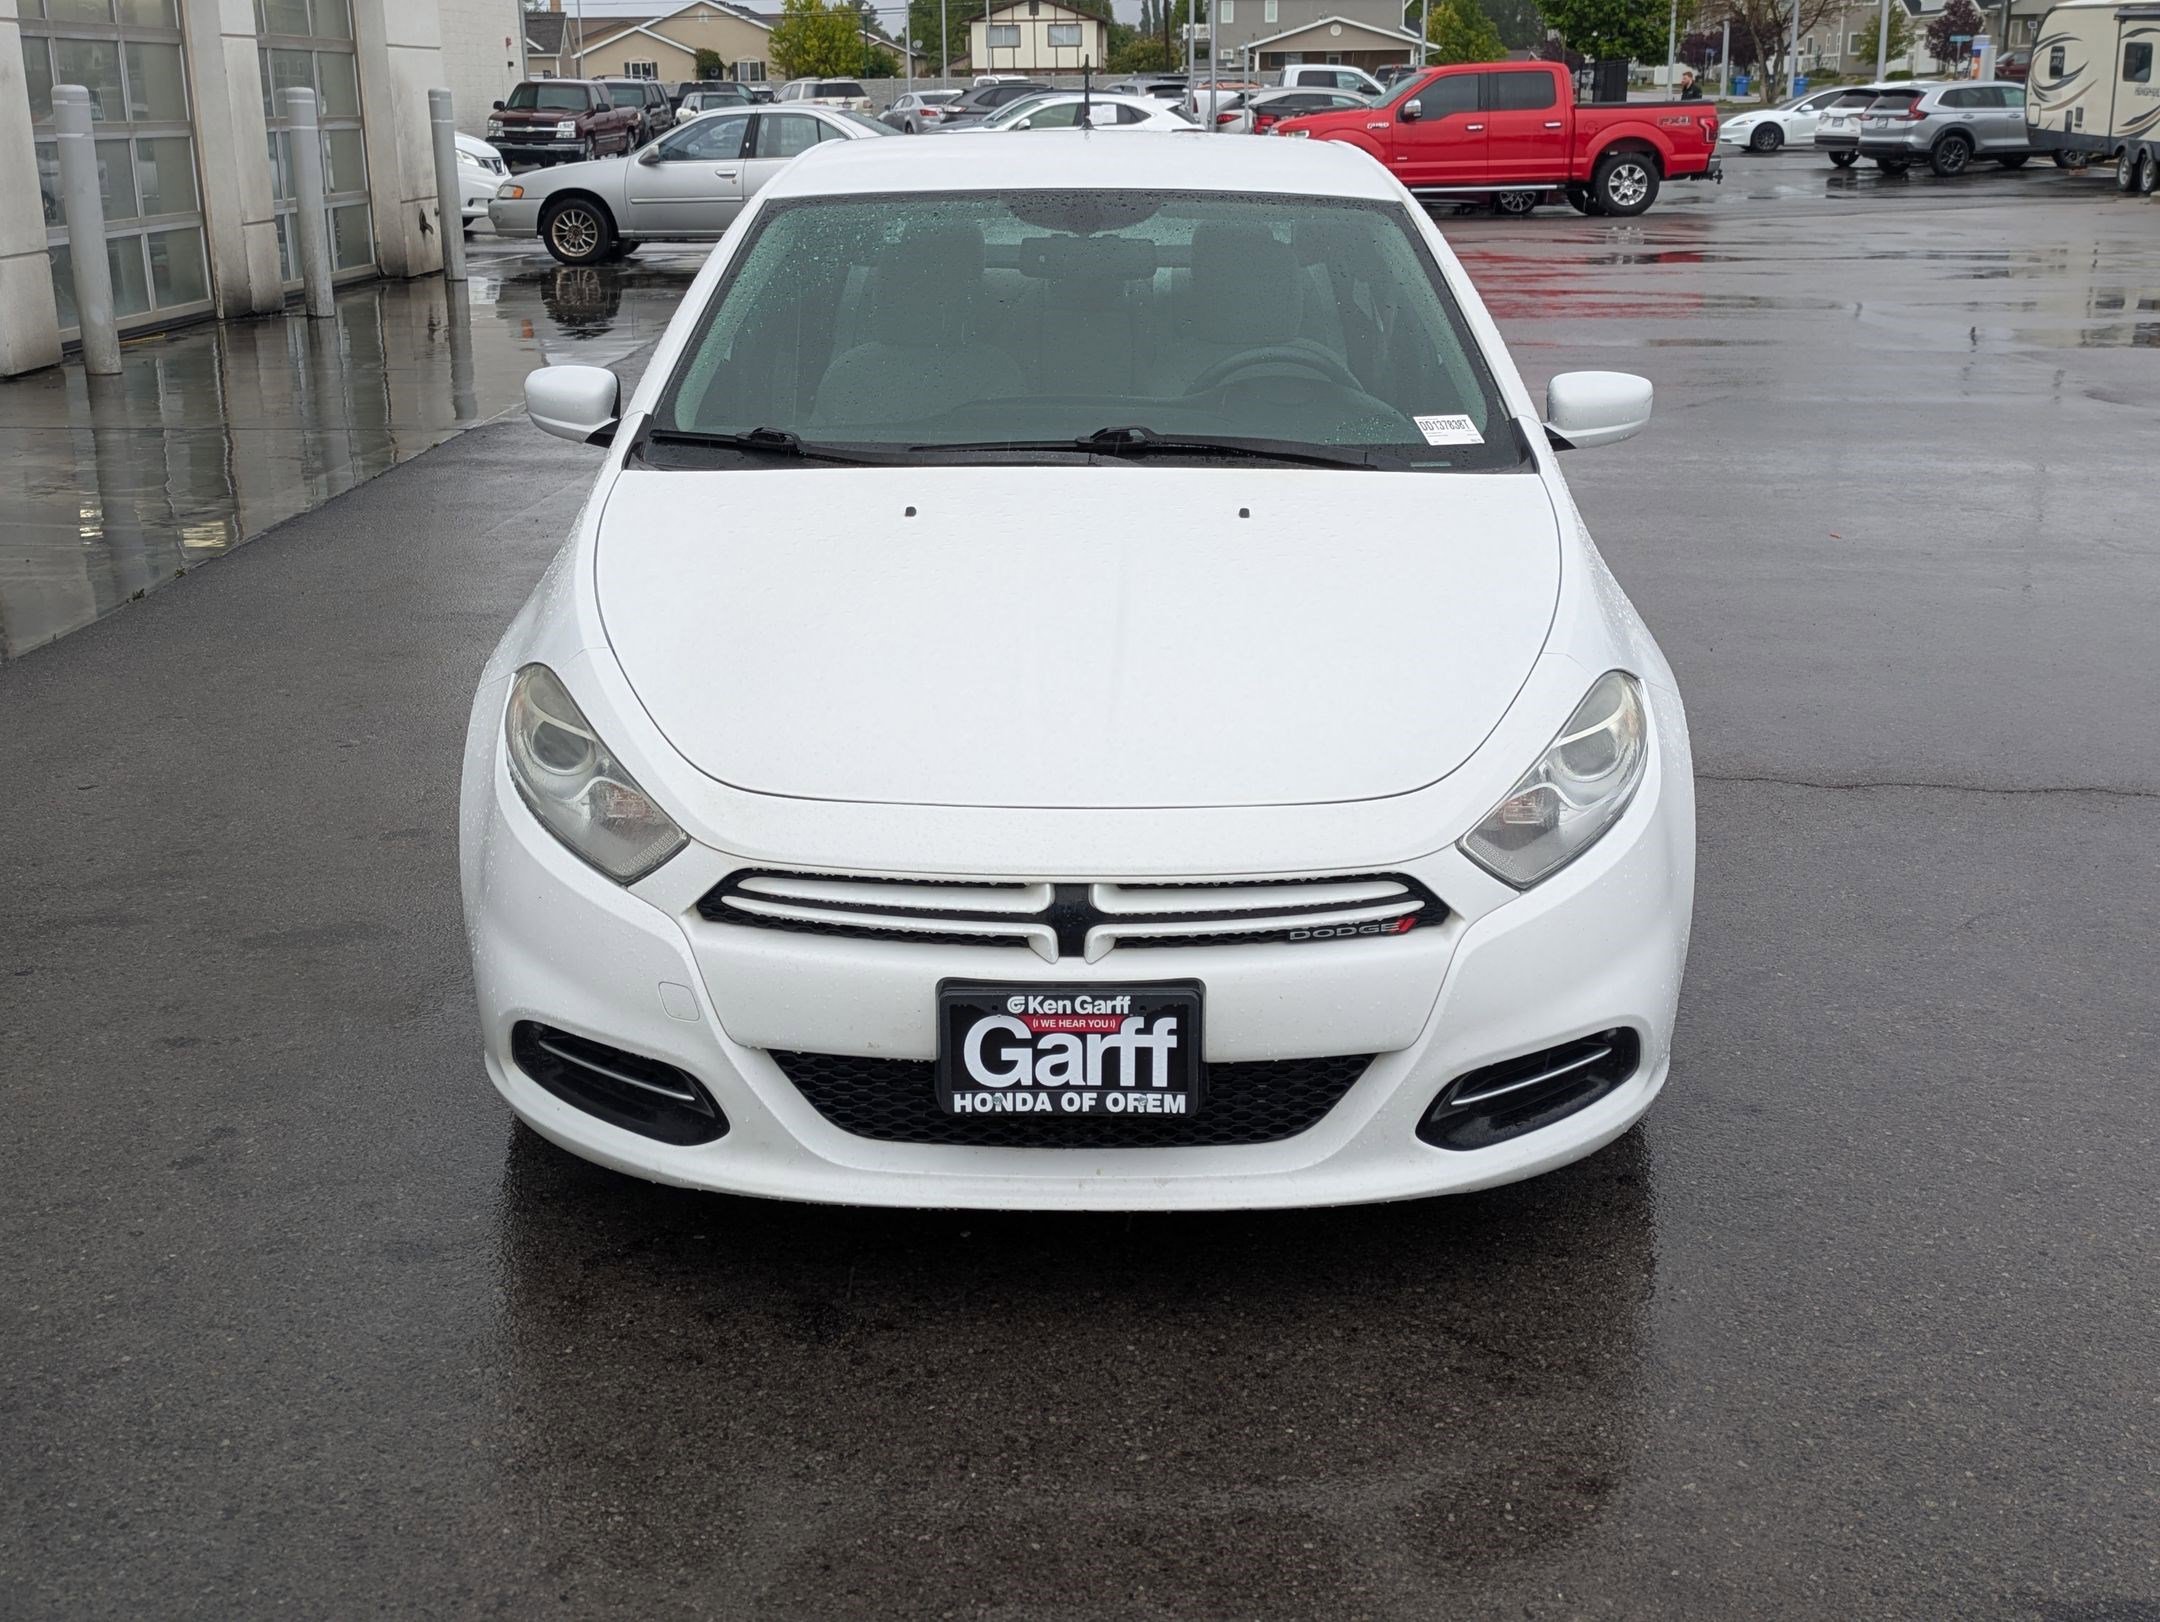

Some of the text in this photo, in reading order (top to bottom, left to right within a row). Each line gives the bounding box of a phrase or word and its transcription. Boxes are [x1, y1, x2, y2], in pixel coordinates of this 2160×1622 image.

[1289, 921, 1400, 940] DODGE
[1027, 995, 1131, 1014] Ken Garff
[1040, 1019, 1109, 1029] WE HEAR YOU
[963, 1014, 1178, 1088] Garff
[953, 1092, 1186, 1114] HONDA OF OREM
